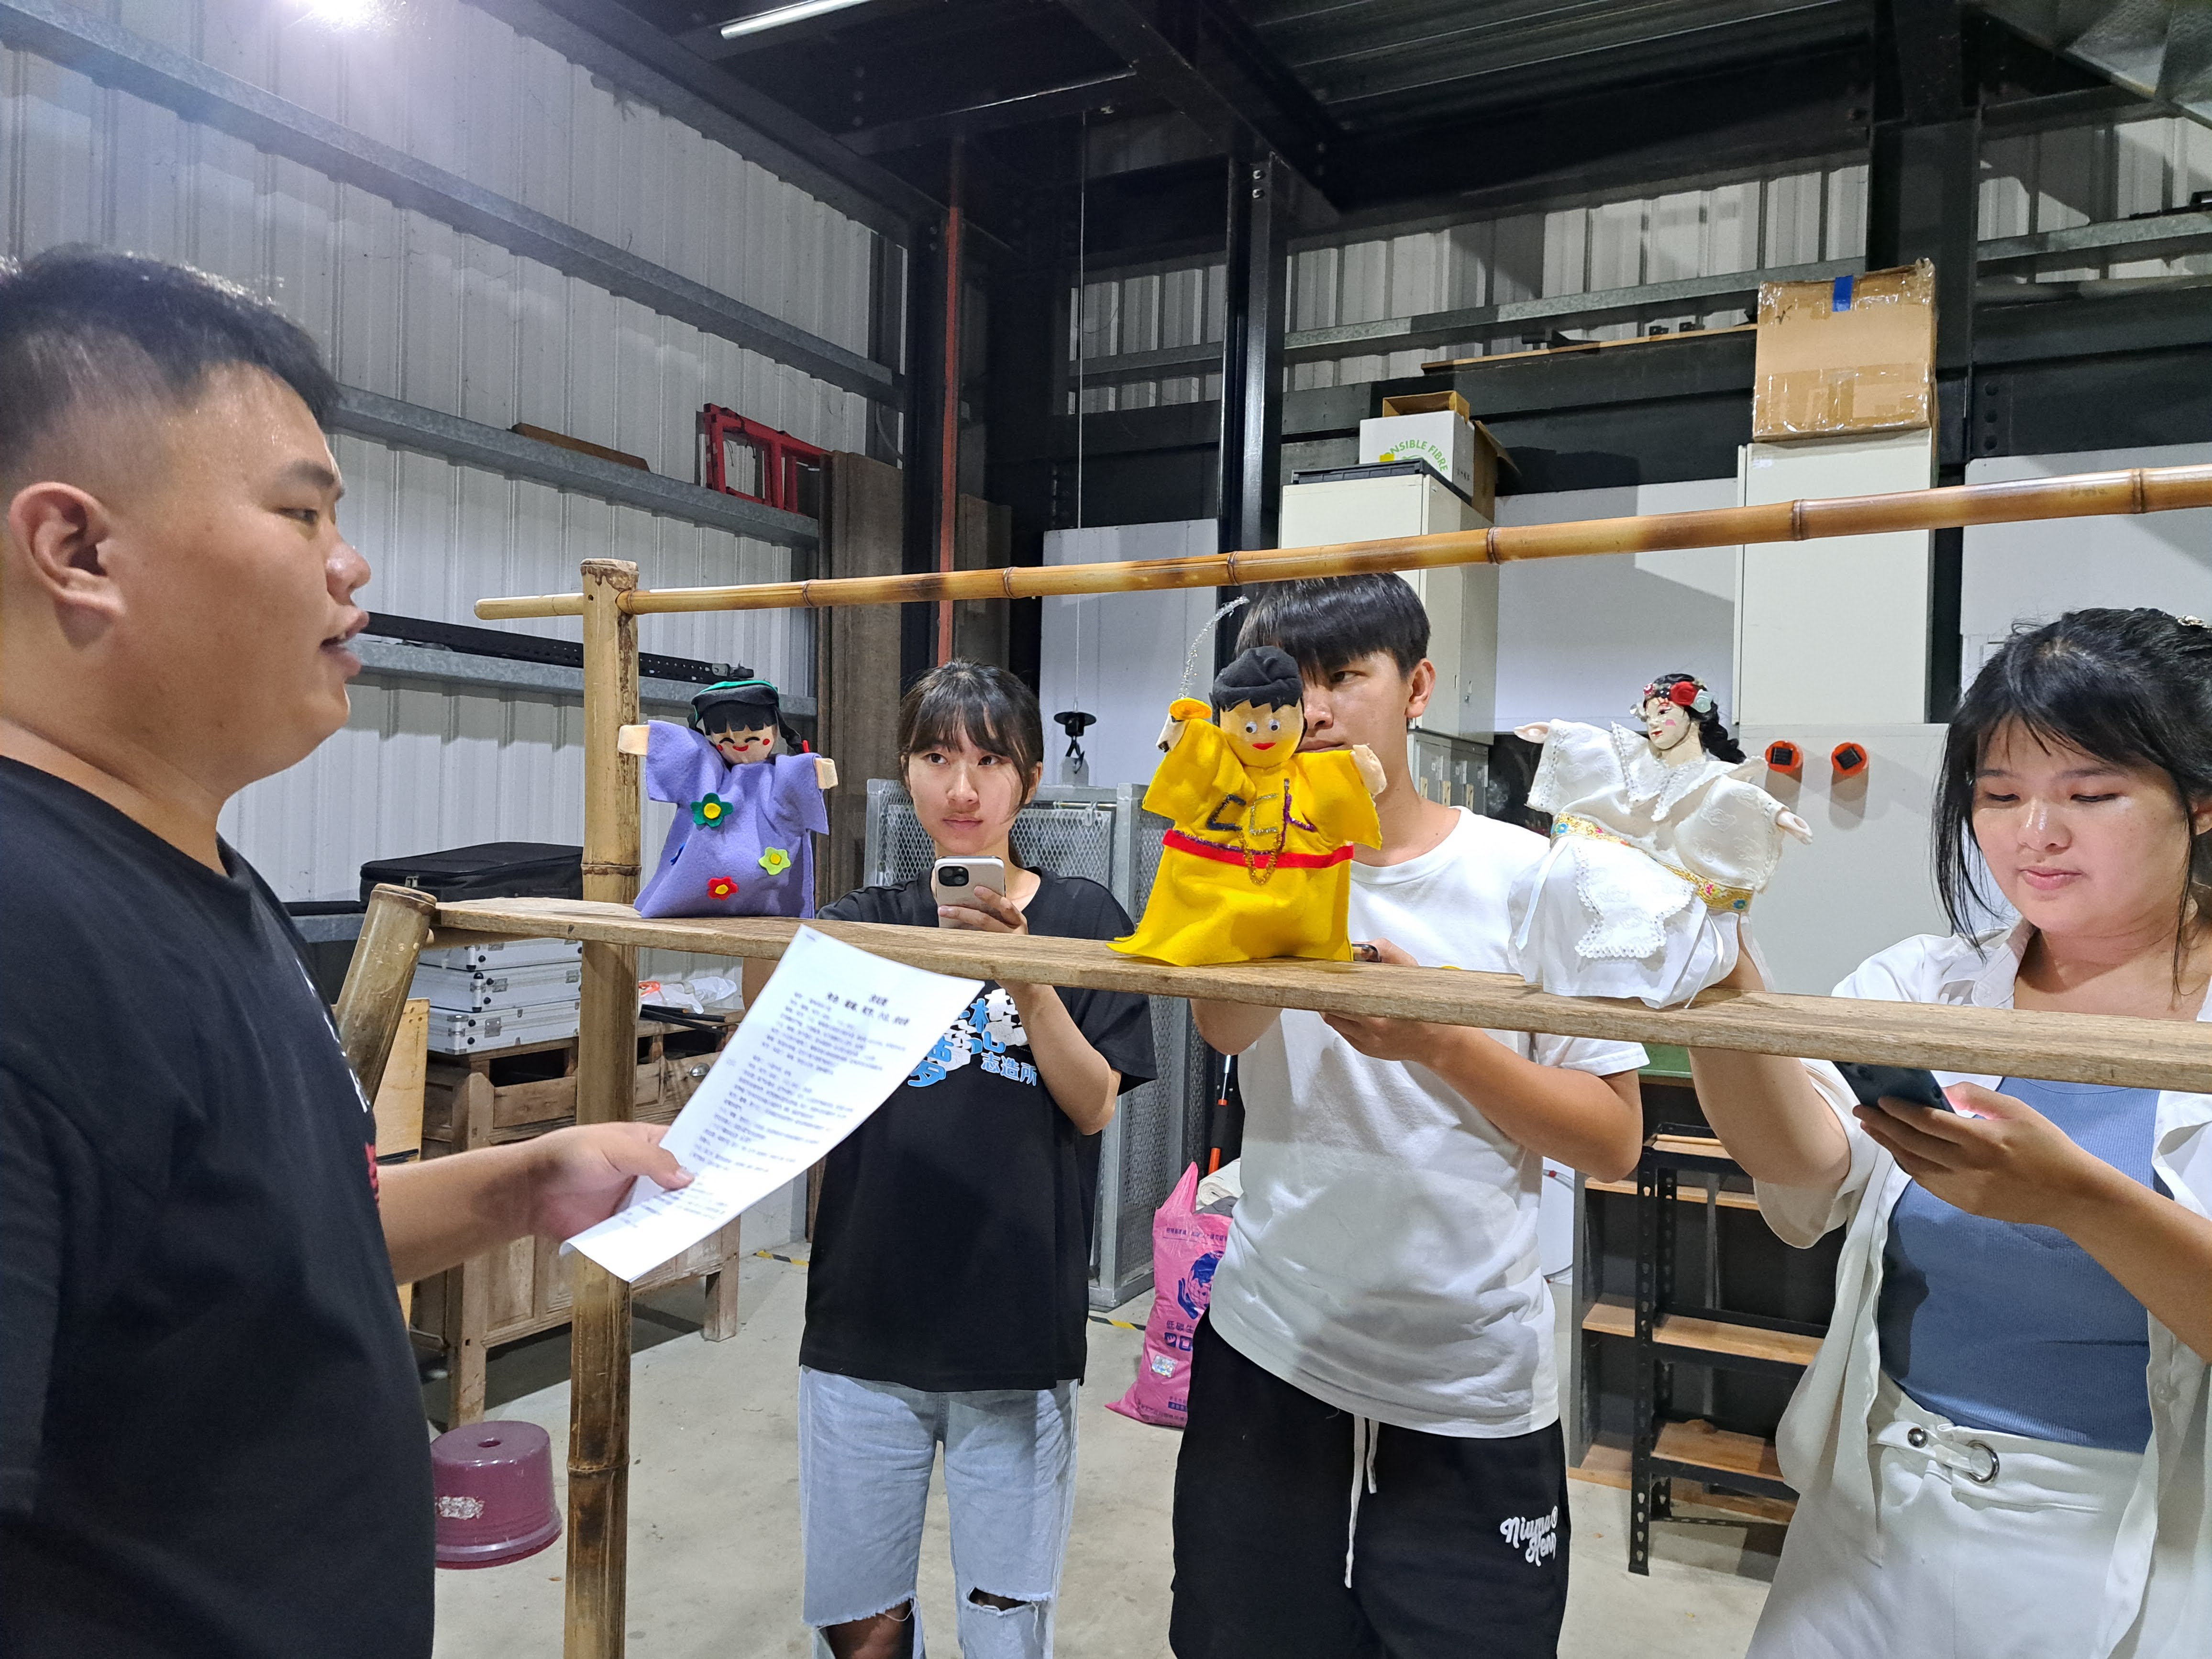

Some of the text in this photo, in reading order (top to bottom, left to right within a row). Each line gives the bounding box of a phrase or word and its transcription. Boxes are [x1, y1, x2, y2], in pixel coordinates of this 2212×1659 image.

[1384, 439, 1448, 472] NSIBLE FIBRE
[981, 1051, 1037, 1086] 志造所
